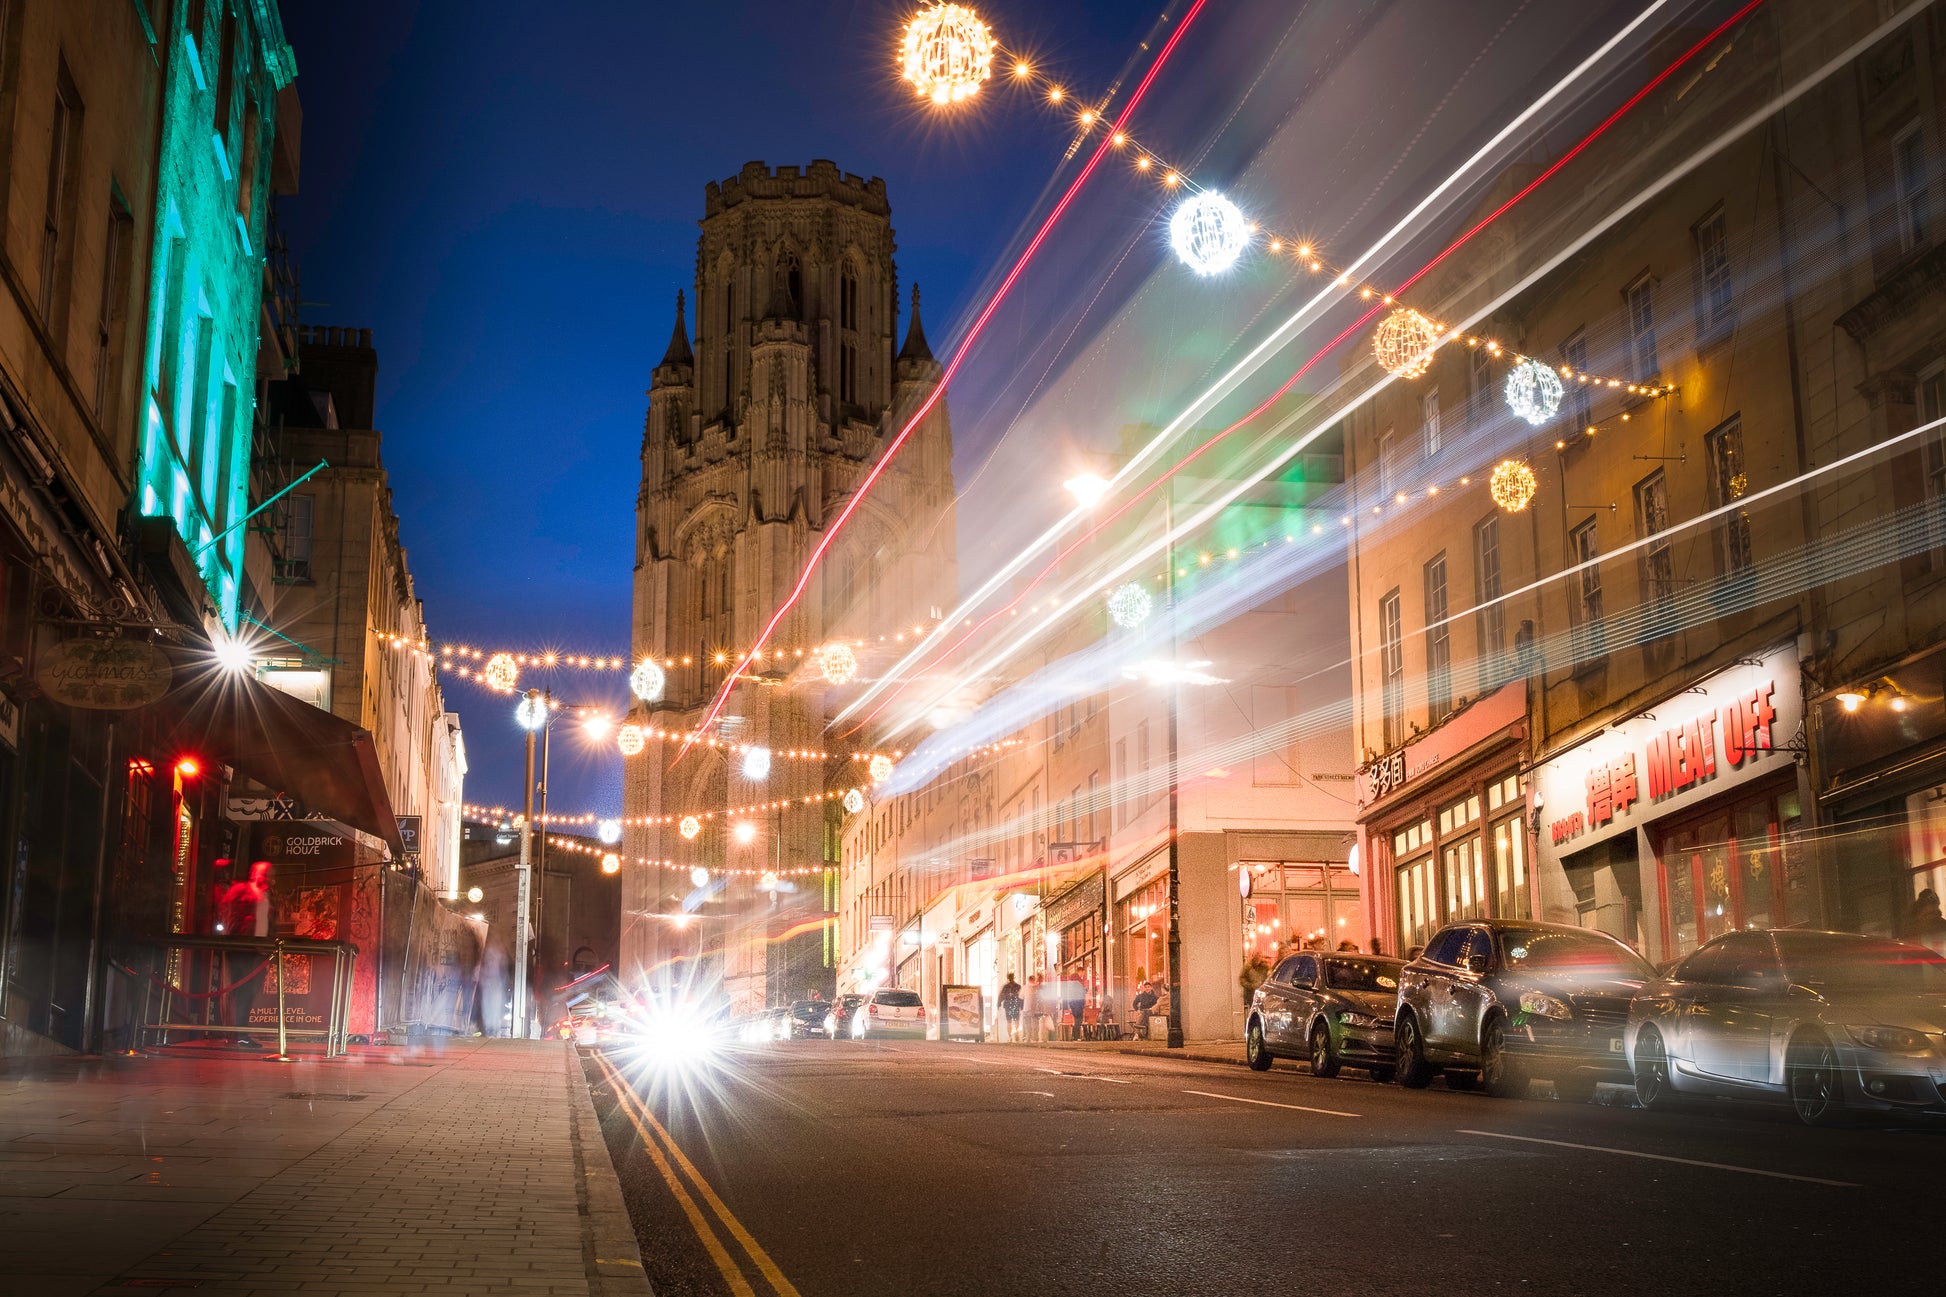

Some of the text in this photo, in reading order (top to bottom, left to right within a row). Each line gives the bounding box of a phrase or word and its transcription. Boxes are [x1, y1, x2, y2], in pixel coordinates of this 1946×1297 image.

[1646, 680, 1775, 799] MEAT OFF
[1369, 750, 1404, 801] 多多面
[286, 836, 343, 846] GOLDBRICK
[286, 846, 320, 855] HOUSE
[250, 1007, 256, 1015] A
[296, 1015, 304, 1023] IN
[305, 1015, 322, 1023] ONE
